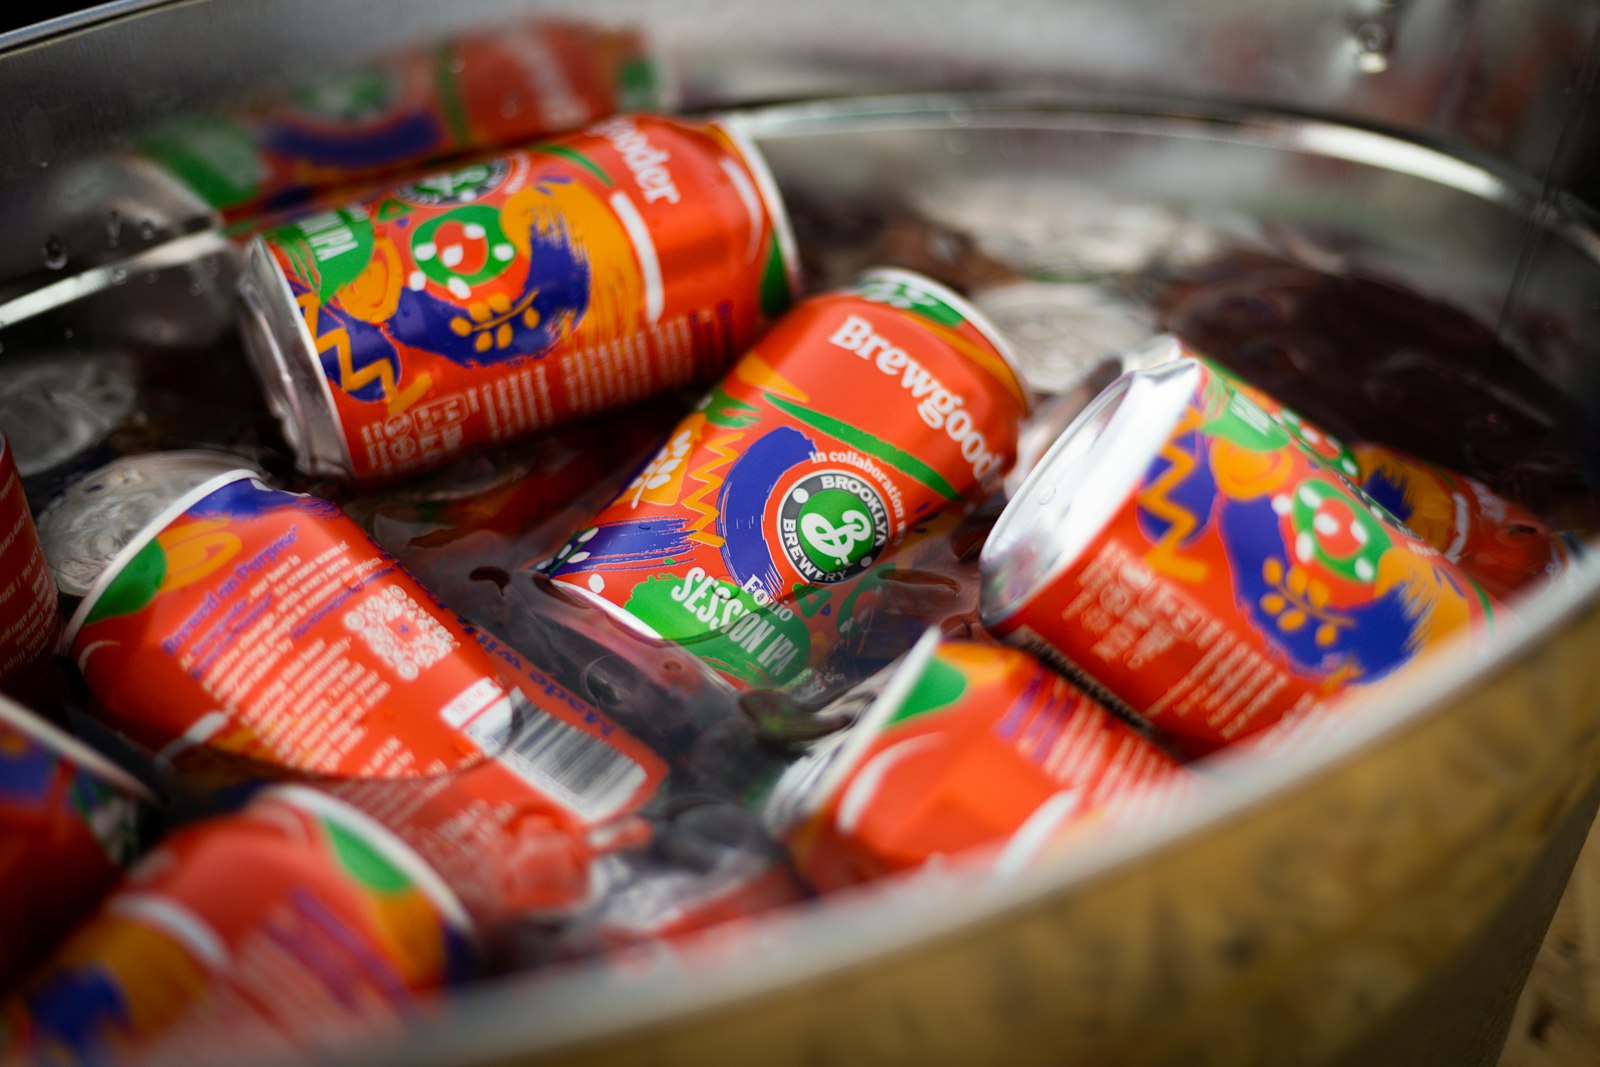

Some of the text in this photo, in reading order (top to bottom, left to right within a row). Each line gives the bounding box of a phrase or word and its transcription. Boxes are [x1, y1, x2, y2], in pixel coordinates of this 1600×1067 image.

[809, 450, 905, 518] in collaboration
[820, 475, 887, 546] BROOKLYN
[783, 518, 847, 581] BREWERY
[741, 574, 793, 621] Fonio
[757, 633, 799, 676] IPA
